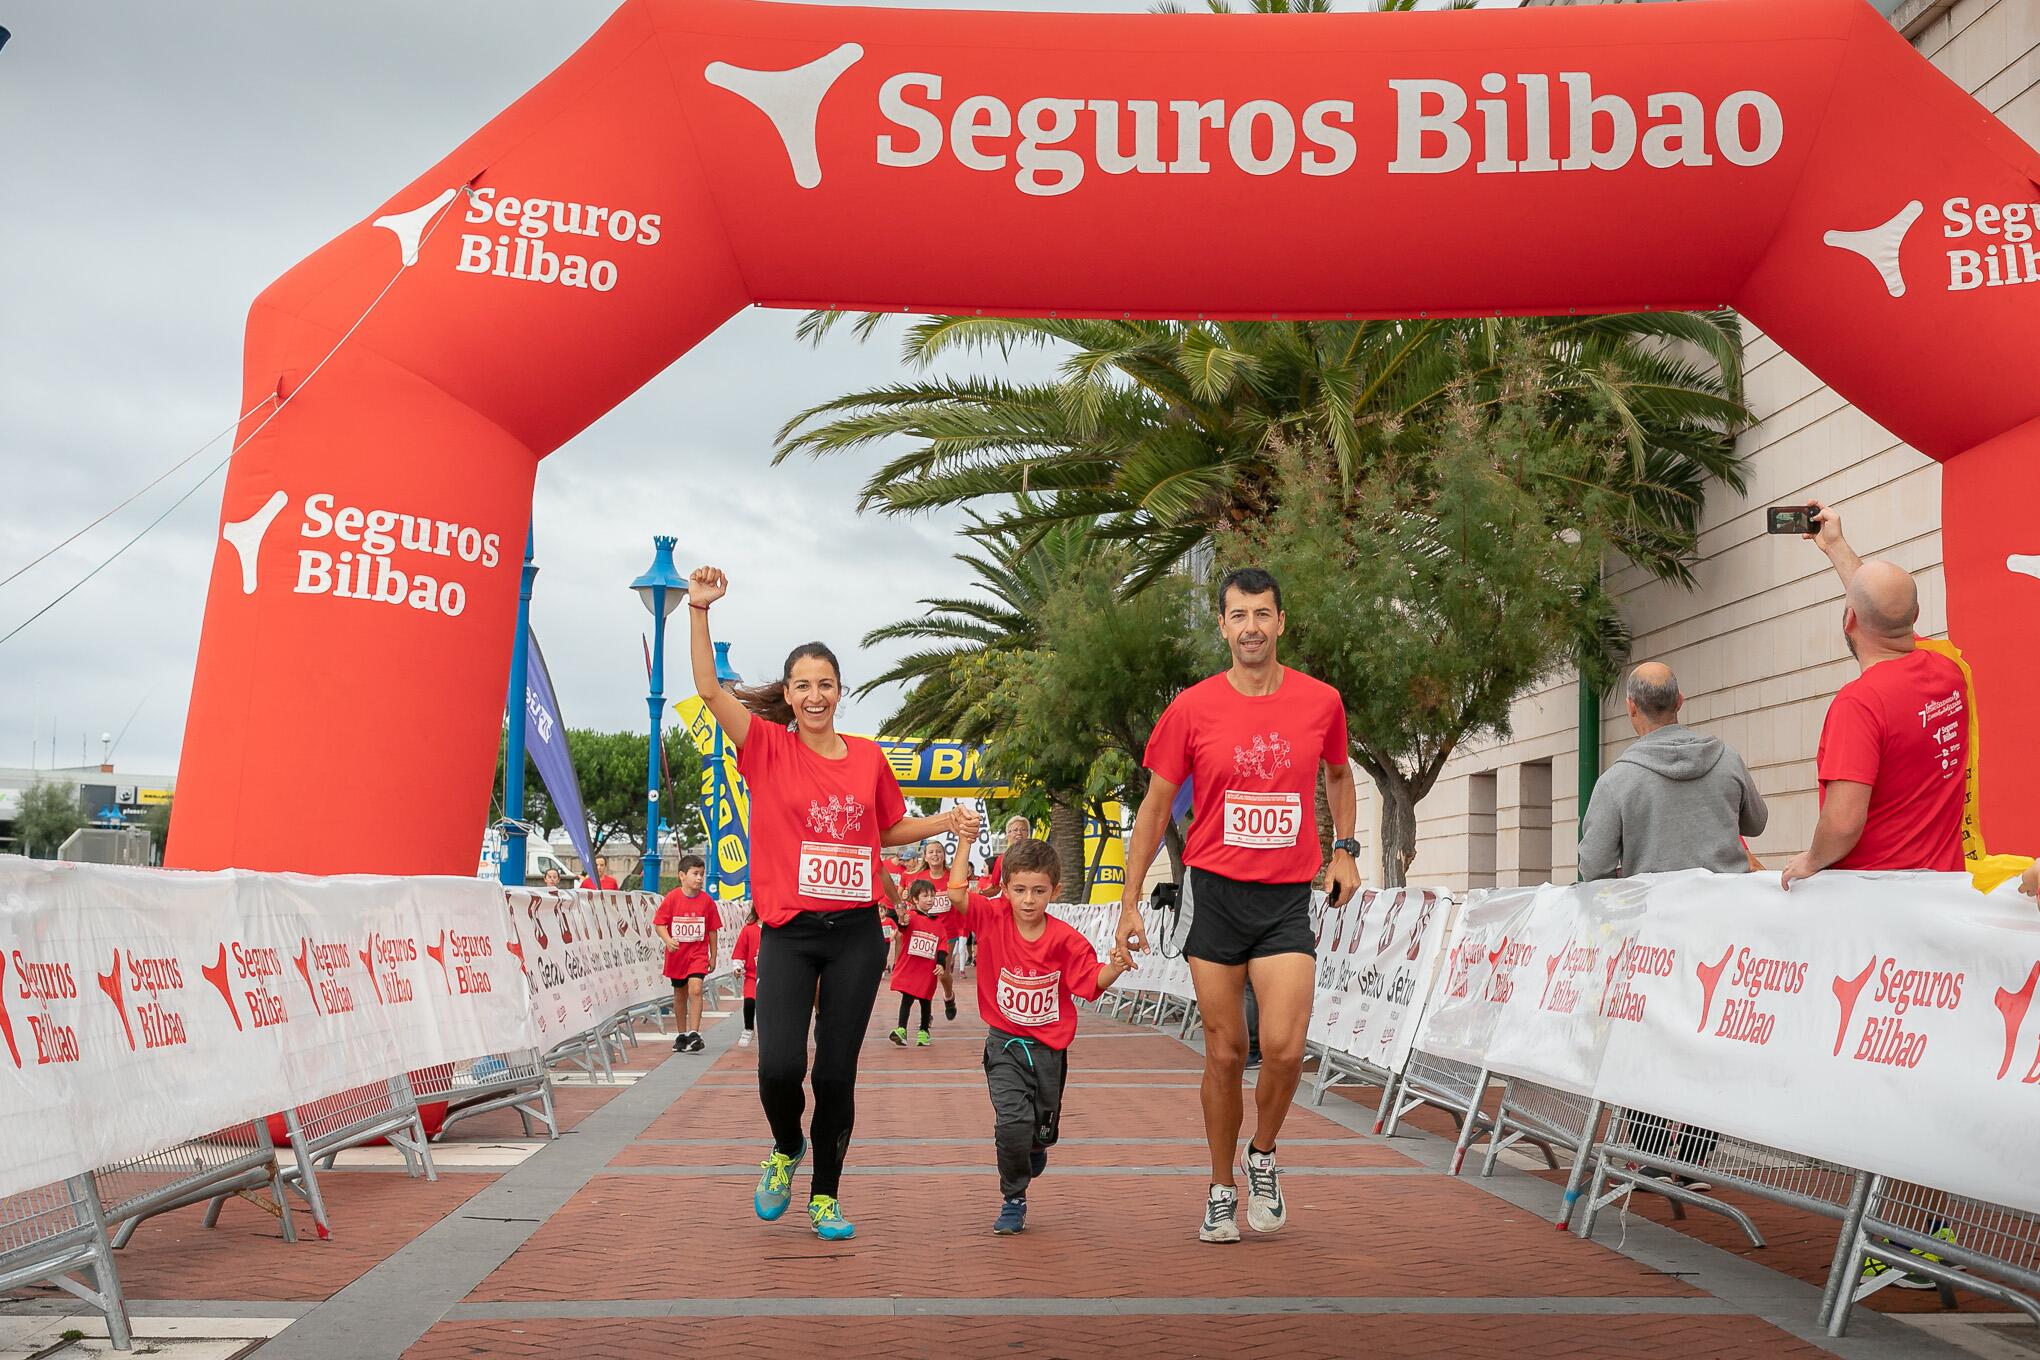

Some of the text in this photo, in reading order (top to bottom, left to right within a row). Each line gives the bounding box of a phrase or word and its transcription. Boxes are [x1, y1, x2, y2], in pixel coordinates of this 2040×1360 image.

[875, 71, 1785, 196] Seguros Bilbao
[464, 186, 662, 246] Seguros
[455, 233, 618, 292] Bilbao
[300, 493, 501, 568] Seguros
[293, 548, 467, 618] Bilbao
[1232, 806, 1294, 836] 3005
[807, 857, 864, 888] 3005
[1100, 867, 1125, 883] BM
[933, 896, 950, 908] 005
[375, 932, 418, 970] Seguros
[450, 929, 492, 964] Seguros
[674, 924, 703, 936] 3004
[911, 937, 936, 953] 3004
[126, 948, 184, 1001] Seguros
[231, 941, 283, 985] Seguros
[309, 937, 351, 977] Seguros
[1731, 946, 1809, 998] Seguros
[12, 949, 78, 1011] Seguros
[319, 978, 354, 1015] Bilbao
[382, 971, 413, 1005] Bilbao
[455, 965, 492, 994] Bilbao
[1003, 986, 1054, 1015] 3005
[1874, 957, 1965, 1016] Seguros
[26, 1012, 81, 1065] Bilbao
[136, 1002, 188, 1049] Bilbao
[1714, 998, 1776, 1046] Bilbao
[1853, 1015, 1928, 1069] Bilbao
